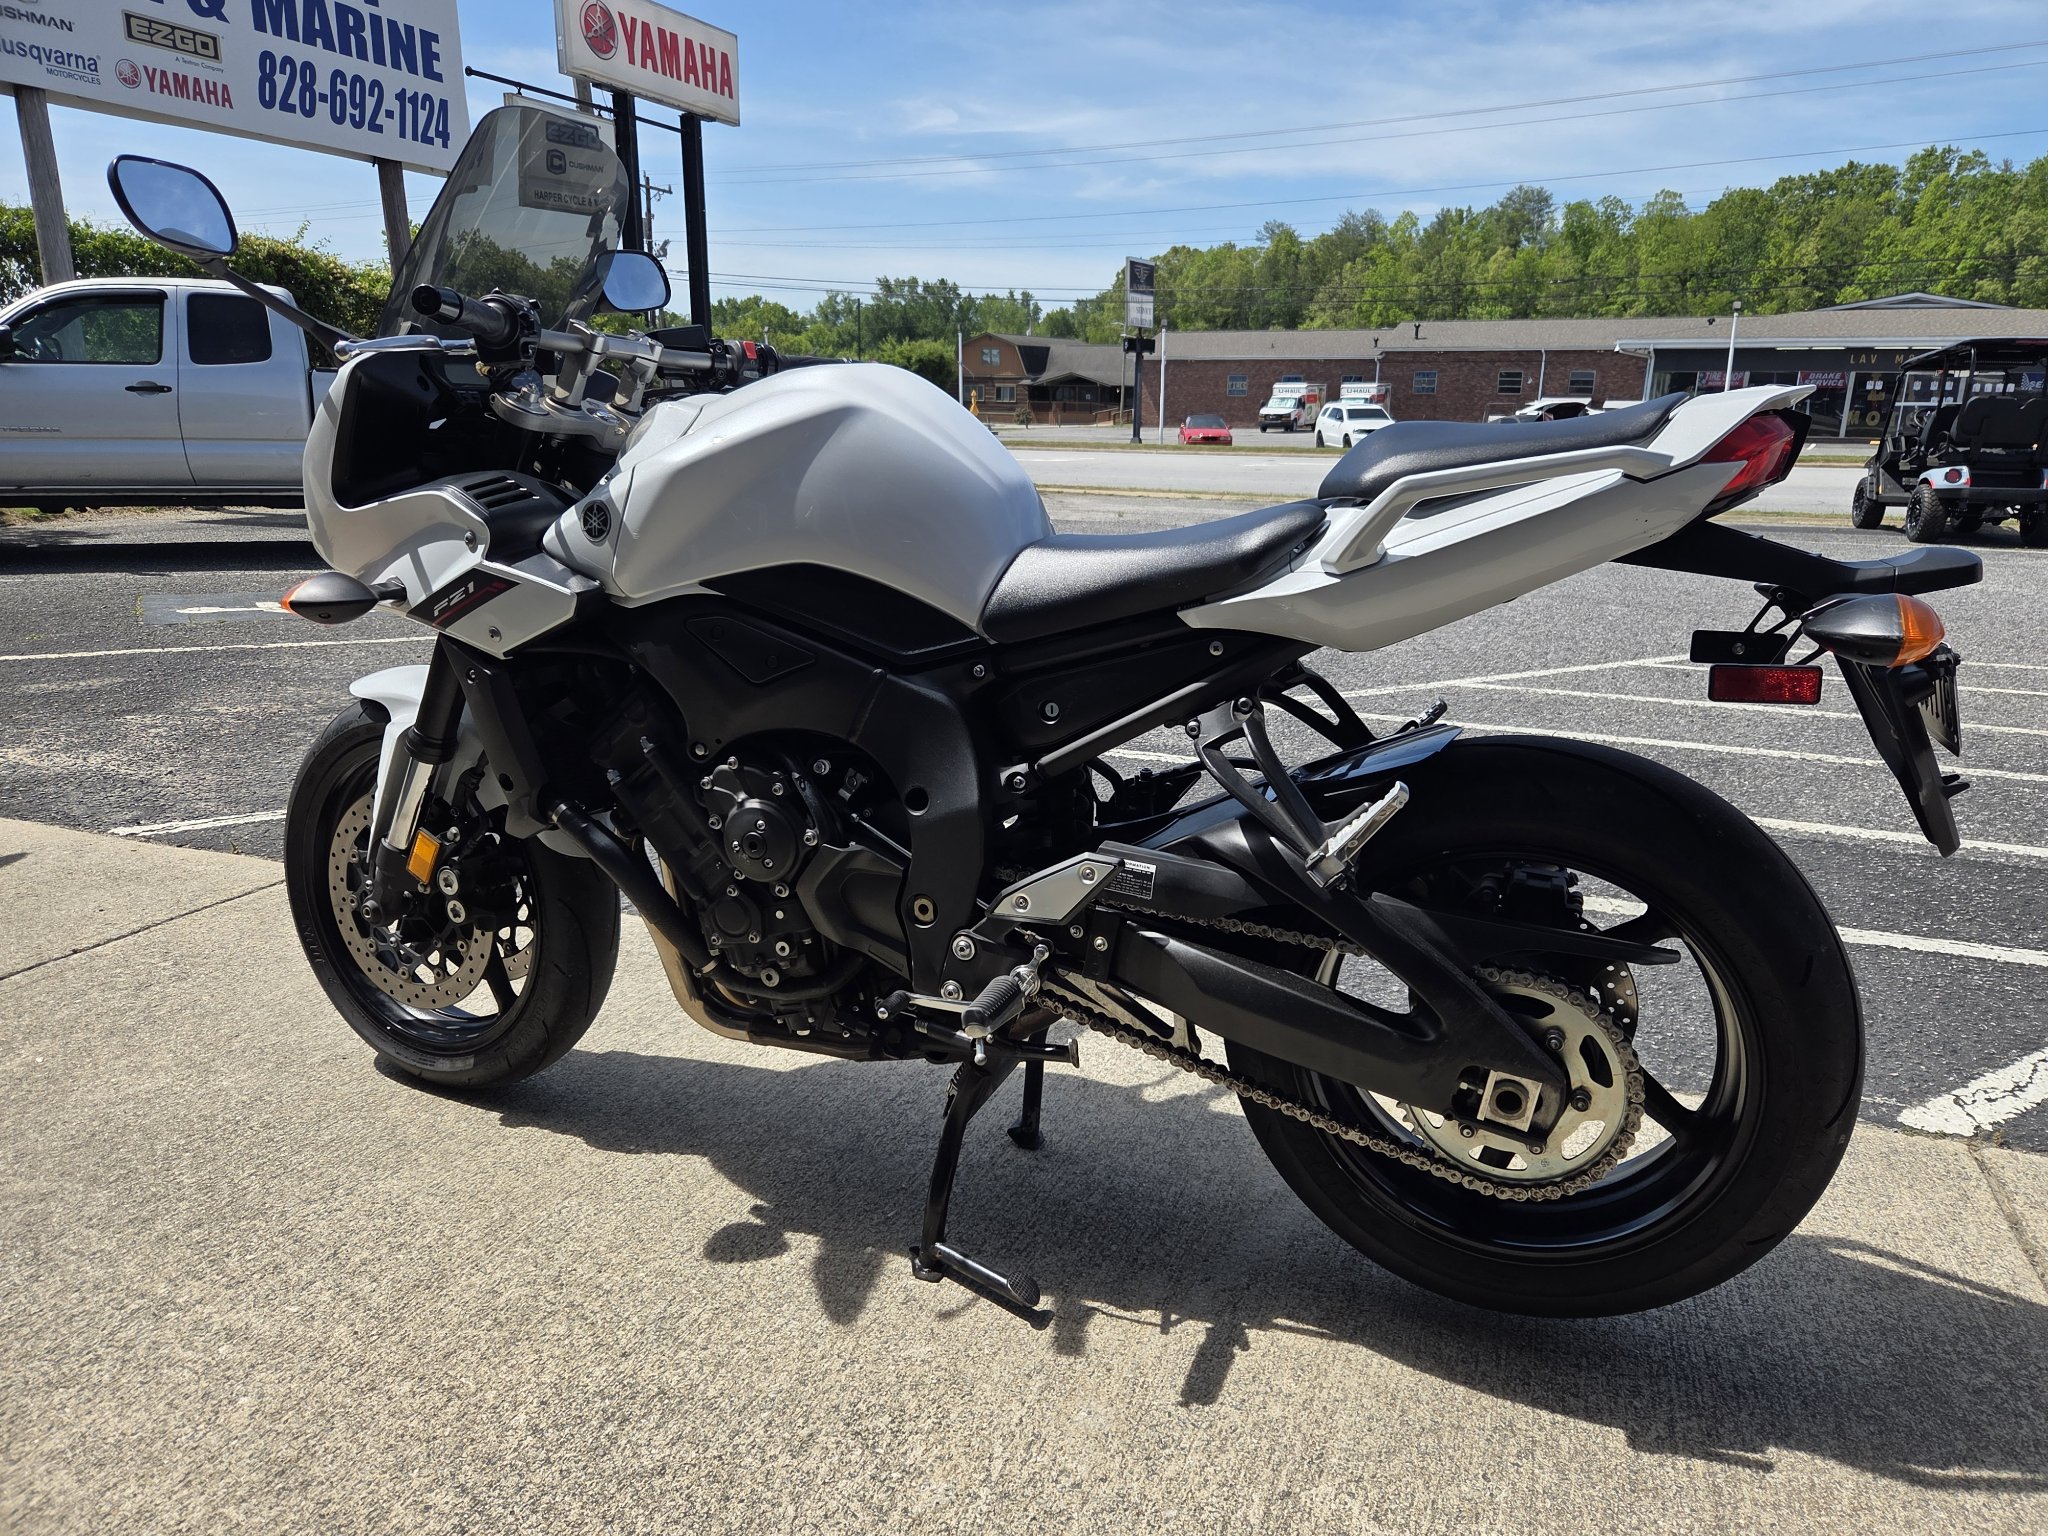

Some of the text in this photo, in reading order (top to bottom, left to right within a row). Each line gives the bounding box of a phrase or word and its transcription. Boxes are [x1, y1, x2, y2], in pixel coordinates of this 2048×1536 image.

[129, 16, 216, 58] EZGO
[252, 0, 444, 84] MARINE
[0, 38, 99, 74] usqvarna
[617, 11, 735, 100] YAMAHA
[46, 67, 102, 86] MOTORCYCLES
[142, 64, 234, 110] YAMAHA
[258, 50, 451, 150] 828-692-1124
[568, 160, 604, 173] CUSHMAN
[534, 189, 562, 203] HARPER
[563, 194, 588, 206] CYCLE
[1849, 353, 1878, 365] LAV
[1704, 371, 1722, 381] TIRE
[1803, 379, 1845, 387] SERVICE
[1808, 372, 1842, 380] BRAKE
[433, 580, 475, 617] FZ1
